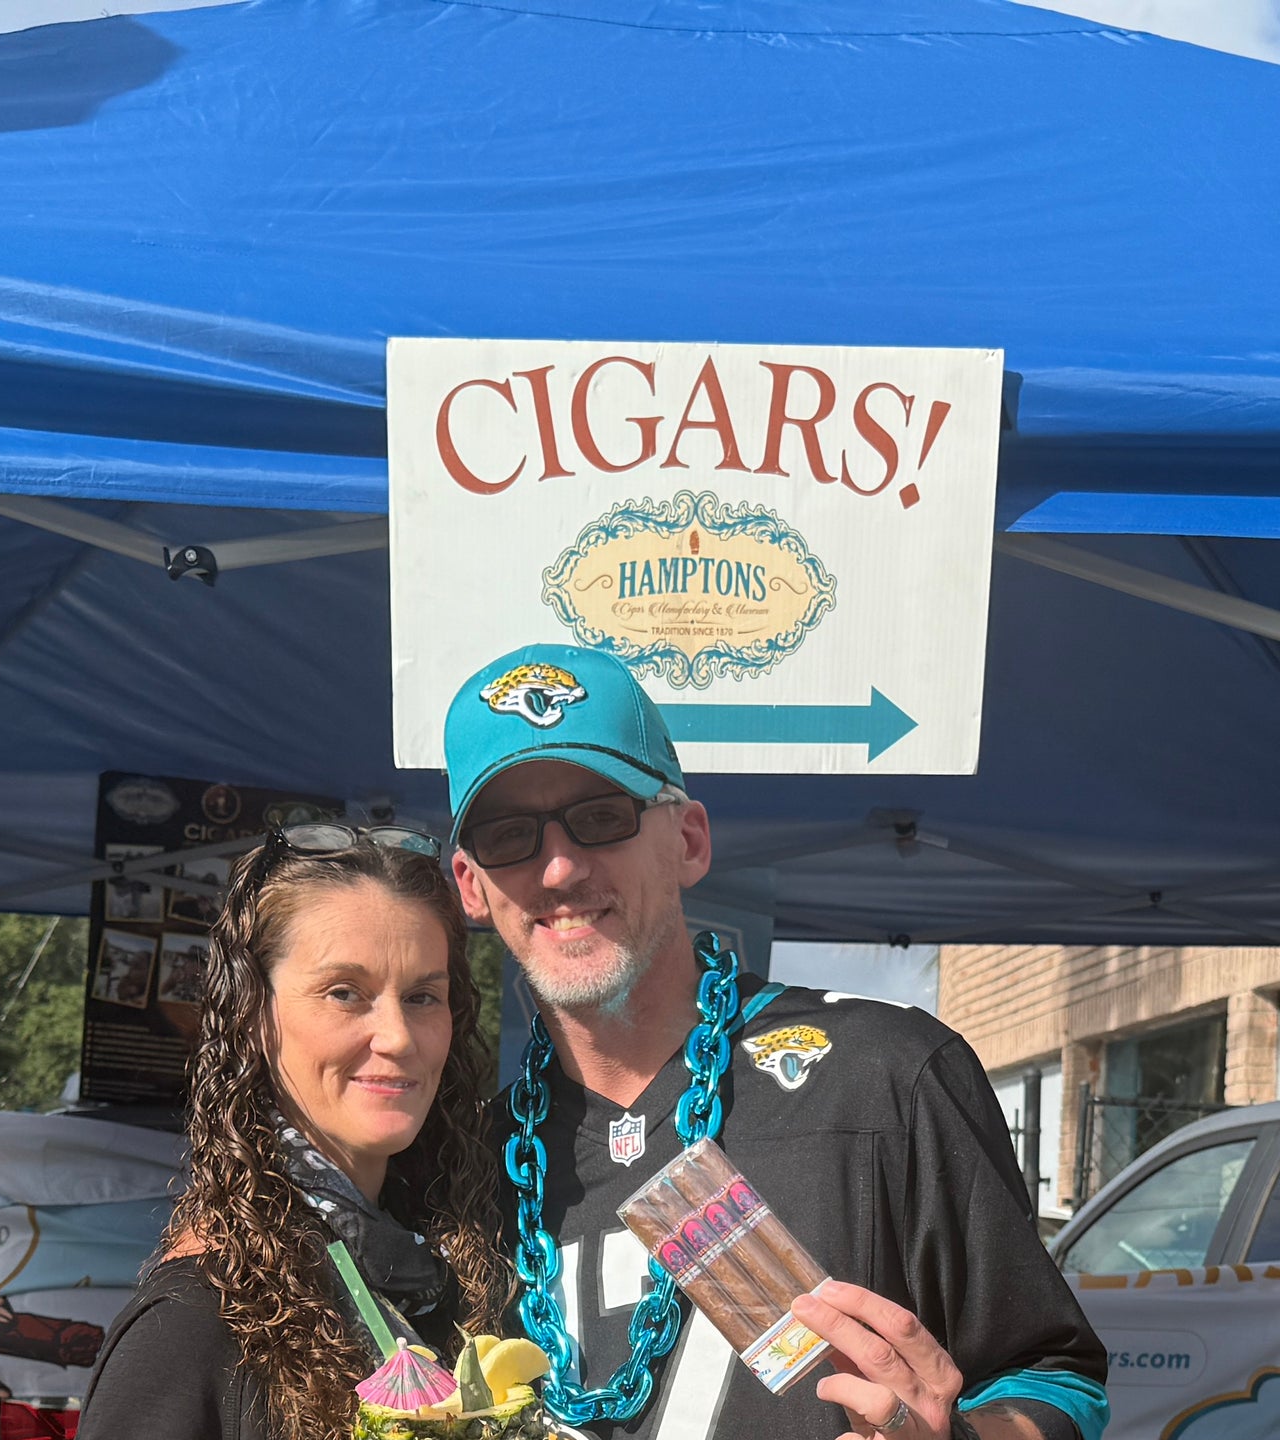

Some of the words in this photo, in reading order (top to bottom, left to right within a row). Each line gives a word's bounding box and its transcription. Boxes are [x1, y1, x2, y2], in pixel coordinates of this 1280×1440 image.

[435, 354, 951, 510] CIGARS!
[617, 557, 767, 603] HAMPTONS
[711, 602, 723, 615] &
[651, 626, 691, 636] TRADITION
[692, 627, 714, 636] SINCE
[716, 627, 733, 636] 1870
[614, 1135, 639, 1150] NFL
